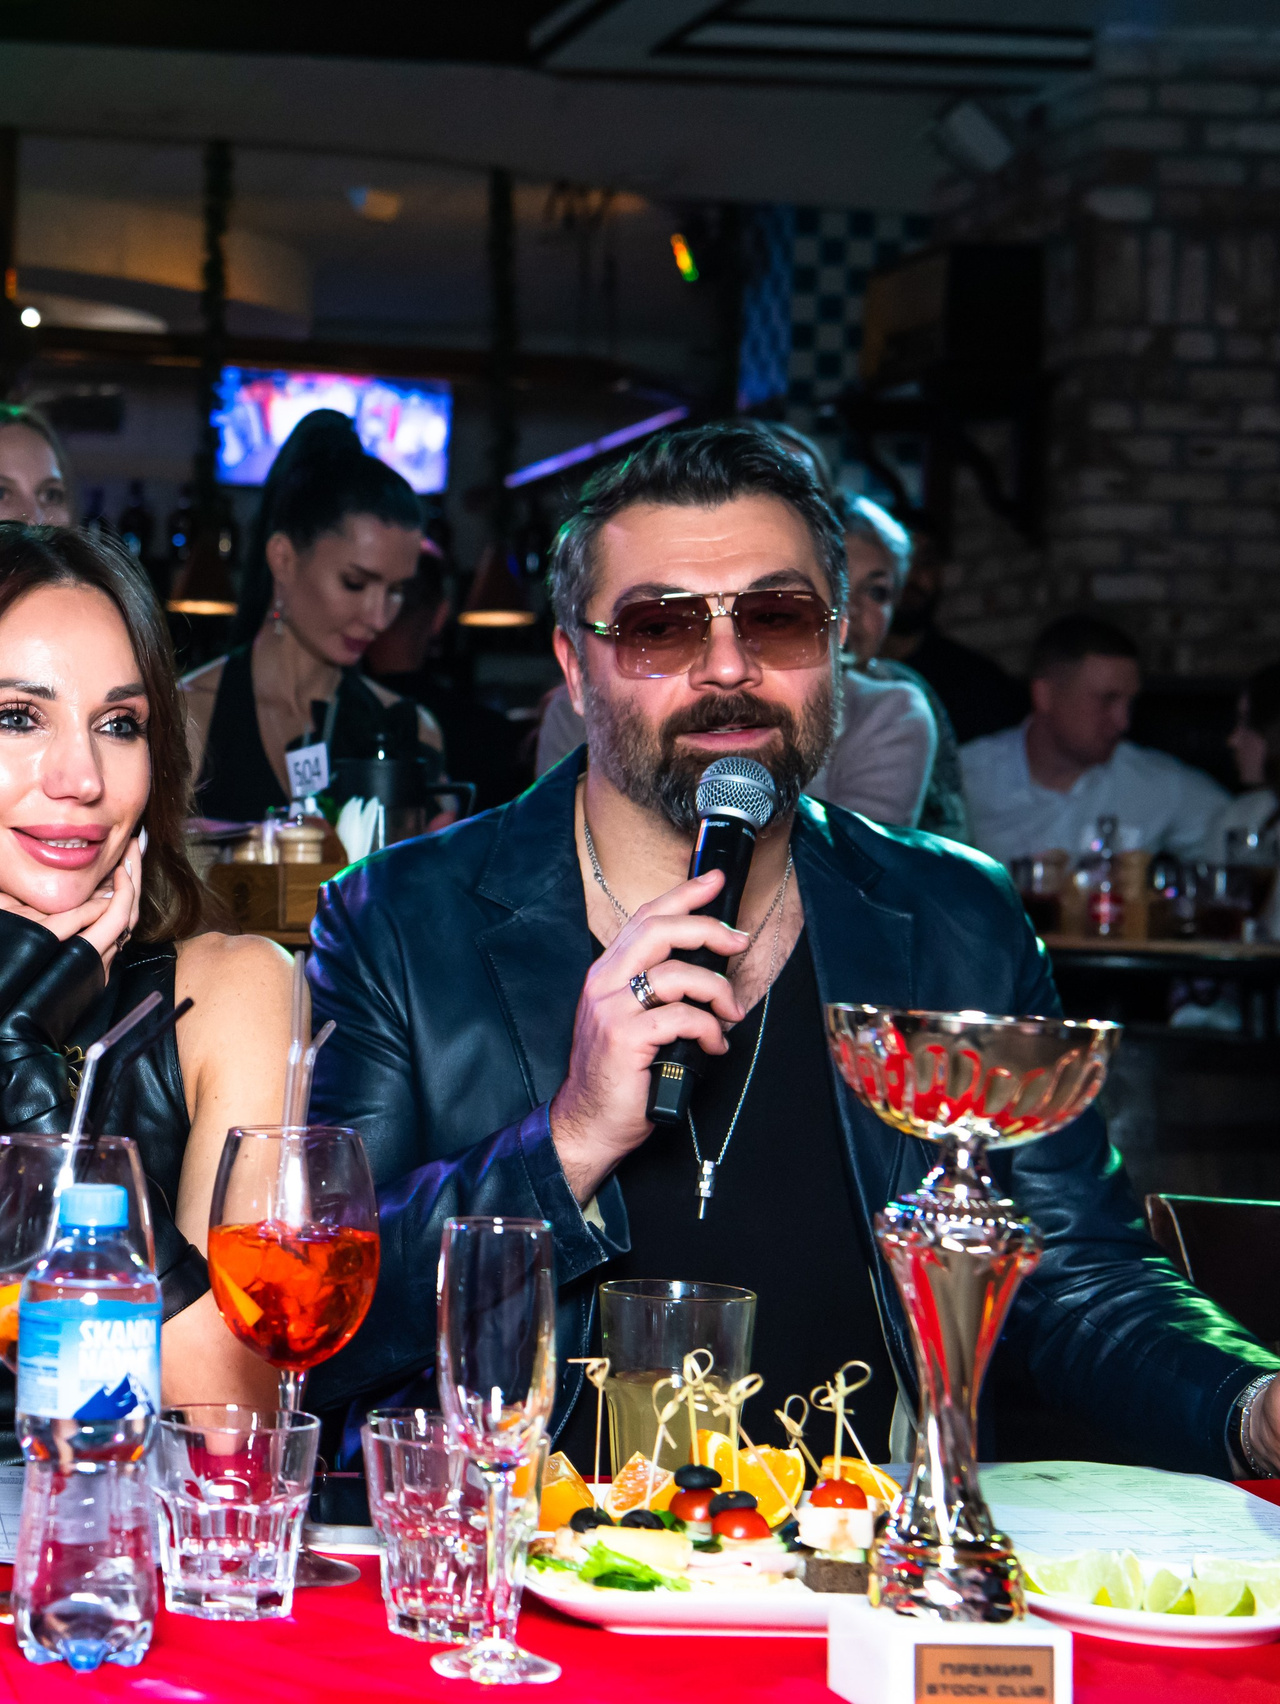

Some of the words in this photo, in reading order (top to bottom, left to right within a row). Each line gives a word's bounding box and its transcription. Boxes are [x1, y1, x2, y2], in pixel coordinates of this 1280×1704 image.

[293, 757, 322, 786] 504
[939, 1662, 1033, 1676] ПРЕМИЯ
[926, 1683, 988, 1697] STOCK
[996, 1684, 1046, 1698] CLUB
